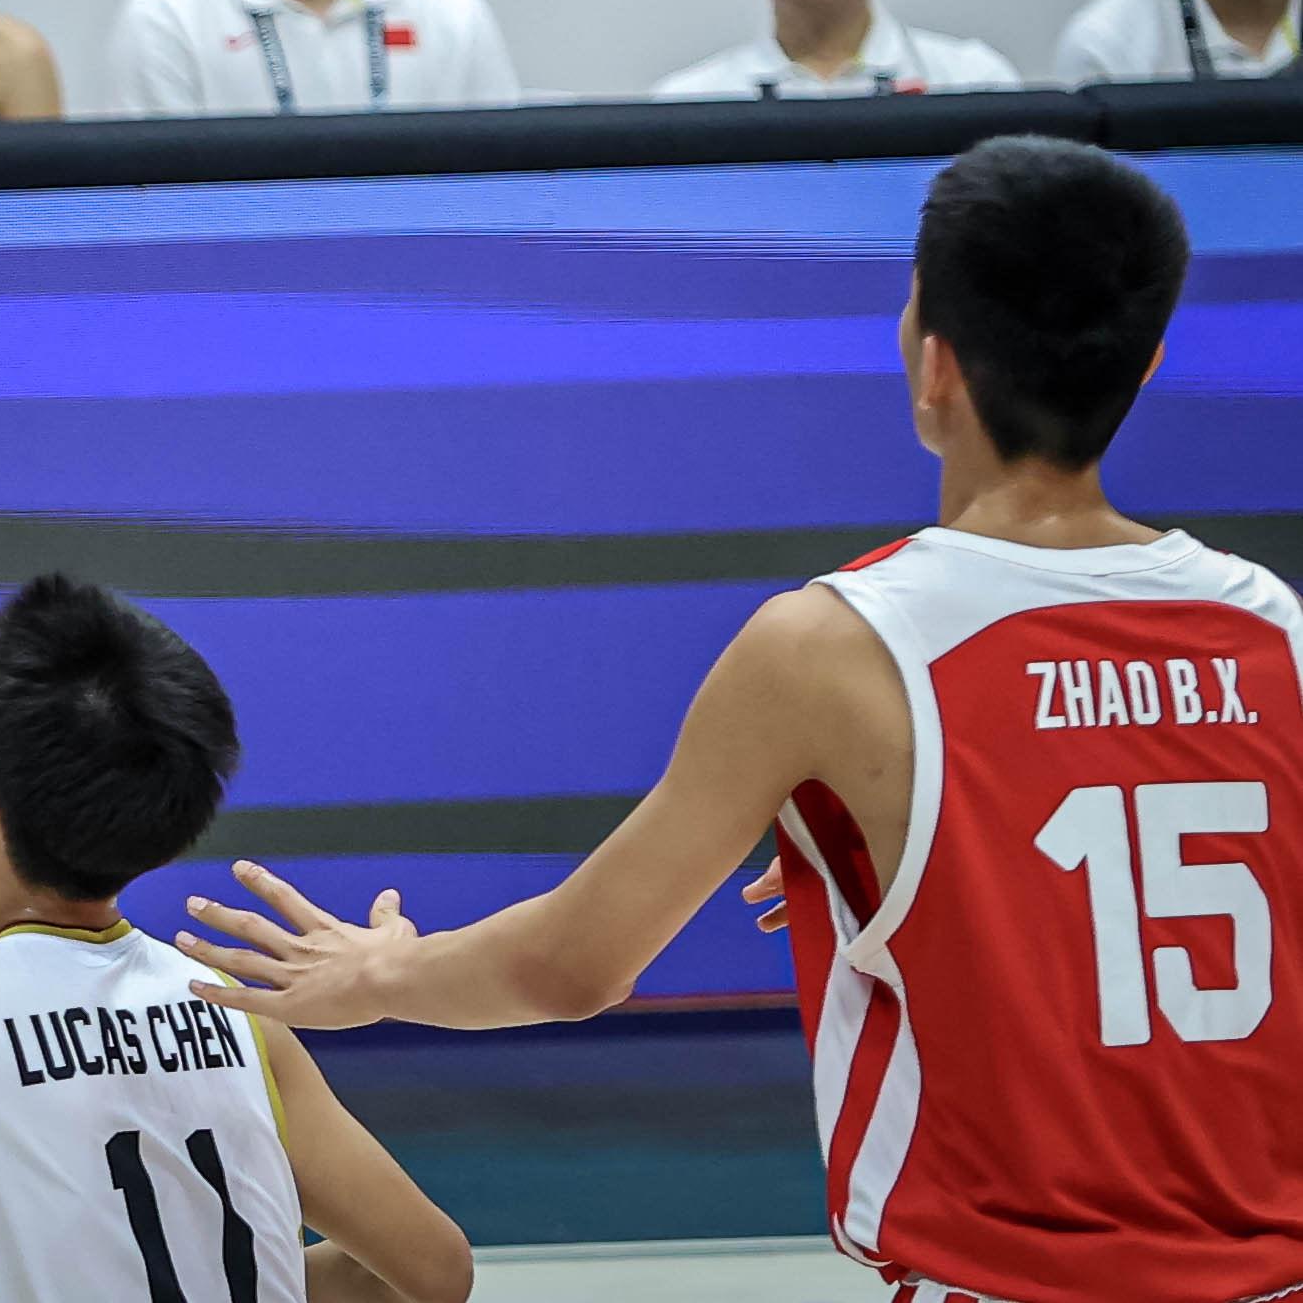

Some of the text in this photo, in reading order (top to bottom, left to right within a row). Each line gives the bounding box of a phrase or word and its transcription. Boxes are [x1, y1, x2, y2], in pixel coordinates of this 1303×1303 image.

[1026, 657, 1259, 730] ZHAO B.X.
[1033, 781, 1273, 1048] 15
[4, 999, 246, 1087] LUCAS CHEN
[104, 1128, 260, 1303] 11
